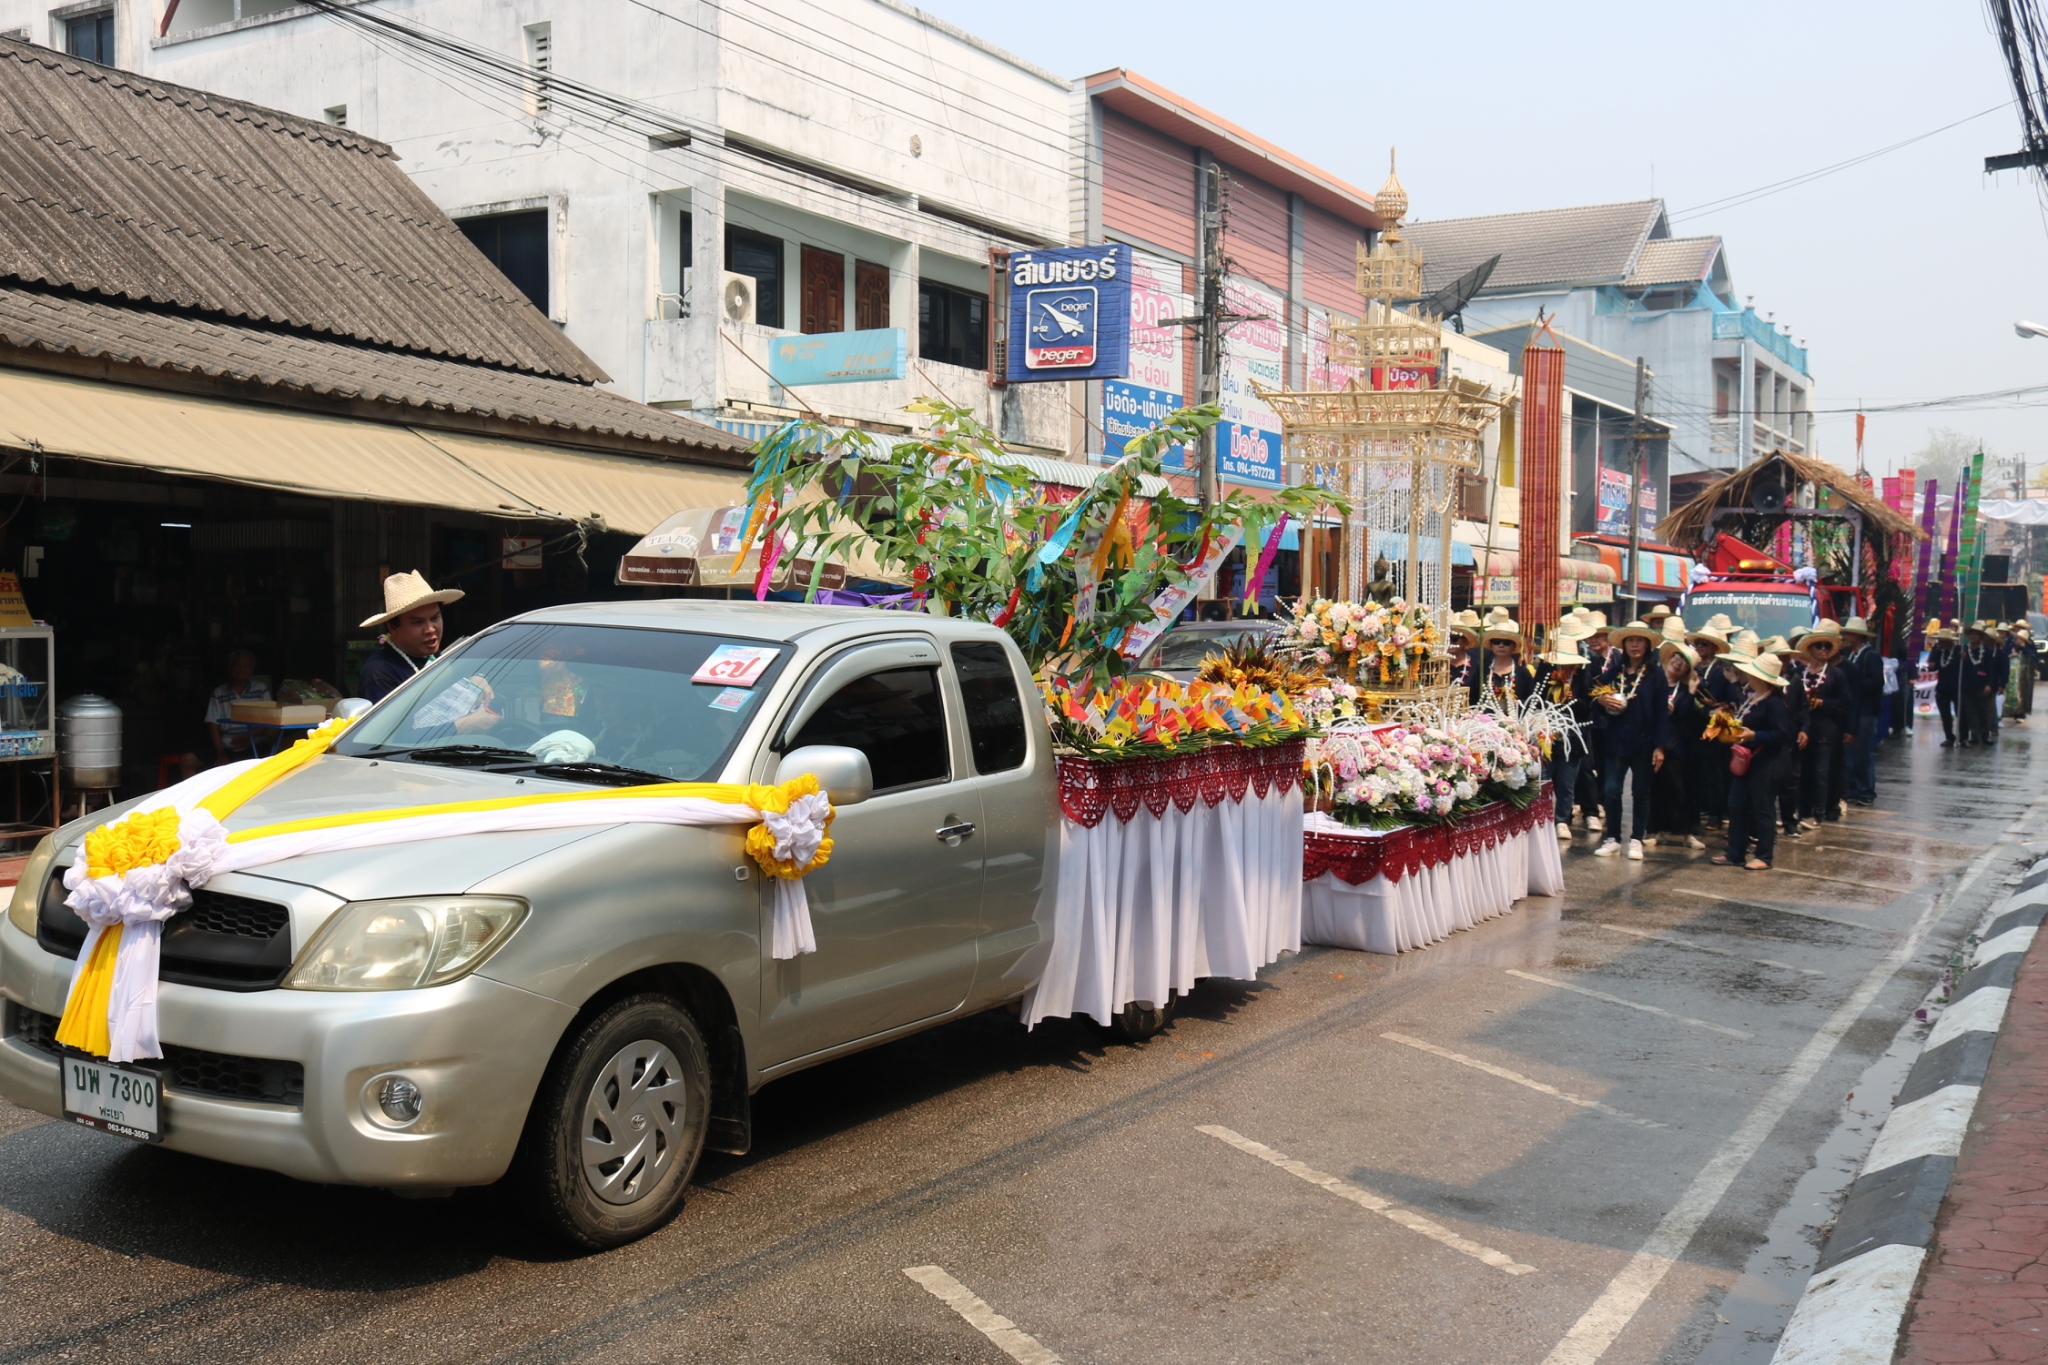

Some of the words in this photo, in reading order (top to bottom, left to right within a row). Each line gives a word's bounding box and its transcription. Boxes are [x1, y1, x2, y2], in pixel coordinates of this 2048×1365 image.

[1013, 248, 1118, 286] สีเบเยอร์
[1061, 302, 1091, 313] beger
[1131, 284, 1174, 331] อถือ
[843, 353, 878, 369] ATM
[1038, 348, 1083, 363] beger
[1230, 424, 1269, 464] มือถือ
[648, 535, 672, 545] TEA
[674, 534, 697, 546] POT
[74, 1064, 100, 1095] บพ
[109, 1072, 154, 1108] 7300
[99, 1105, 125, 1122] พะเยา
